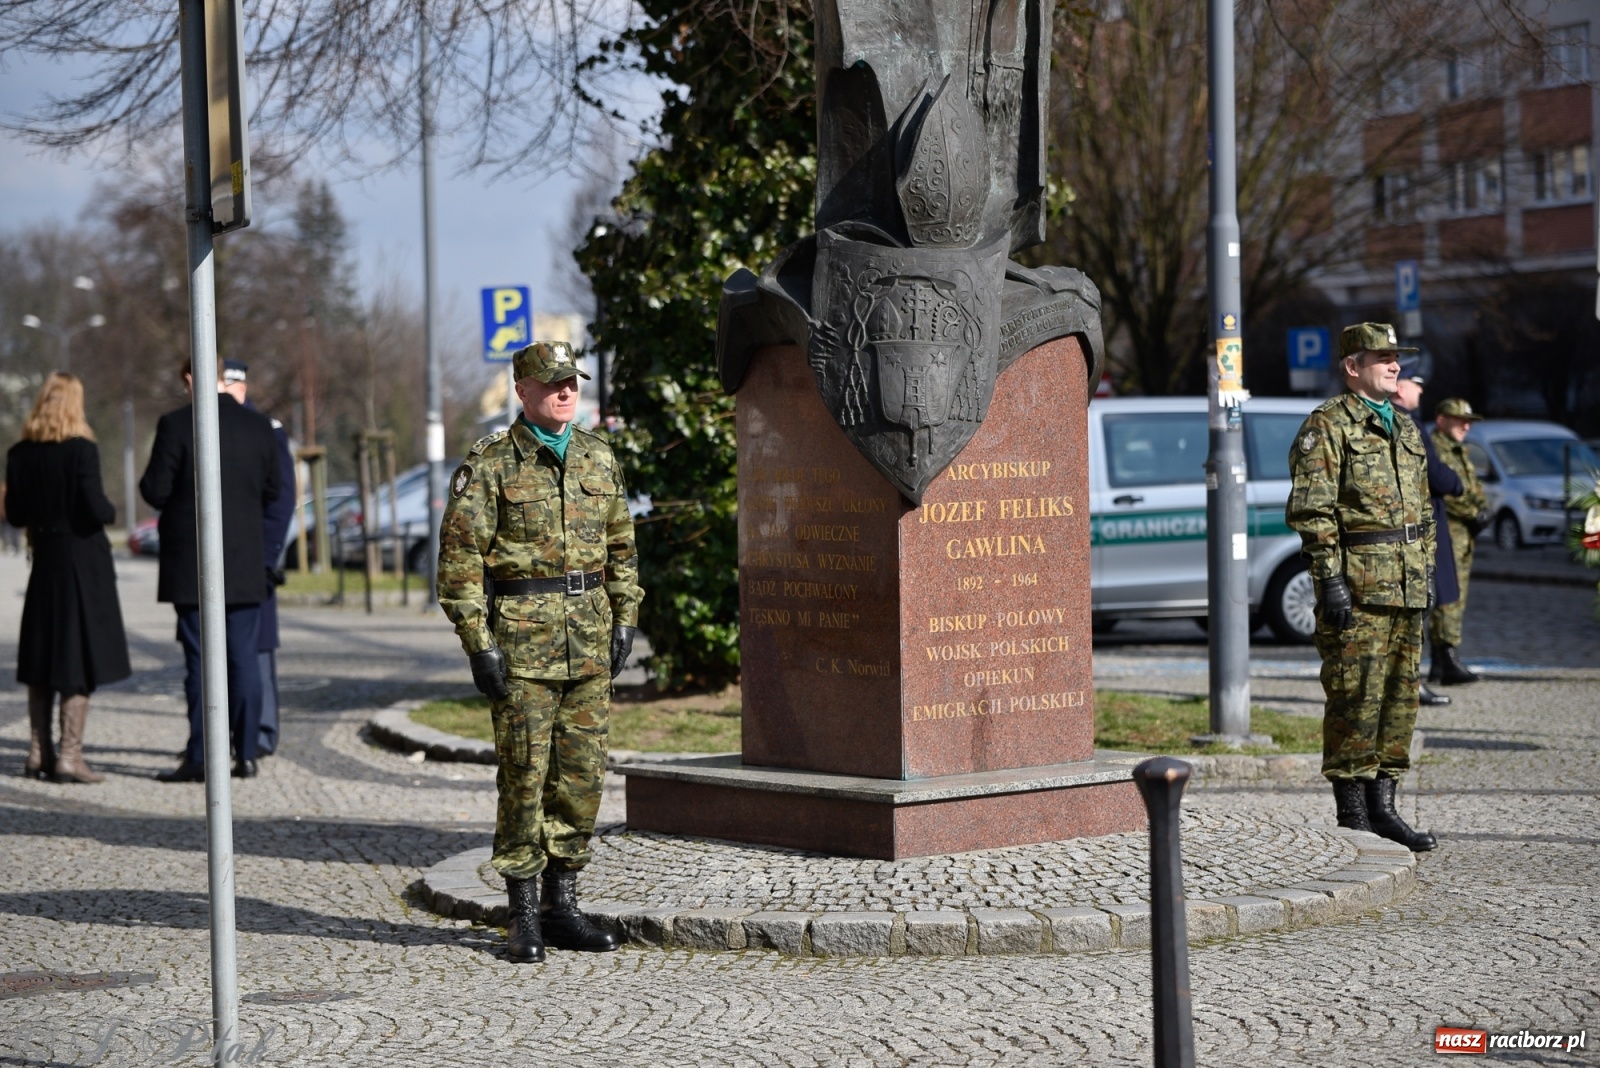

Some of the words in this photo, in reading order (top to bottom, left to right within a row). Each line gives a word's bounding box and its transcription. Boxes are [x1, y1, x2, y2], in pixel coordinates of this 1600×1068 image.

[493, 289, 523, 324] P
[1297, 333, 1322, 366] P
[946, 461, 1051, 481] ARCYBISKUP
[1000, 496, 1074, 520] FELIKS
[795, 525, 860, 542] ODWIECZNE
[946, 535, 1046, 559] GAWLINA
[817, 554, 877, 572] WYZNANIE
[784, 581, 858, 600] POCHWALONY
[957, 577, 984, 591] 1892
[1012, 573, 1038, 587] 1964
[799, 611, 811, 626] MI
[929, 614, 987, 633] BISKUP
[997, 608, 1066, 628] POLOWY
[926, 643, 982, 661] WOJSK
[990, 636, 1070, 657] POLSKICH
[848, 660, 890, 677] Norwid
[963, 667, 1035, 687] OPIEKUN
[912, 699, 1002, 721] EMIGRACJI
[1010, 691, 1085, 713] POLSKIEJ
